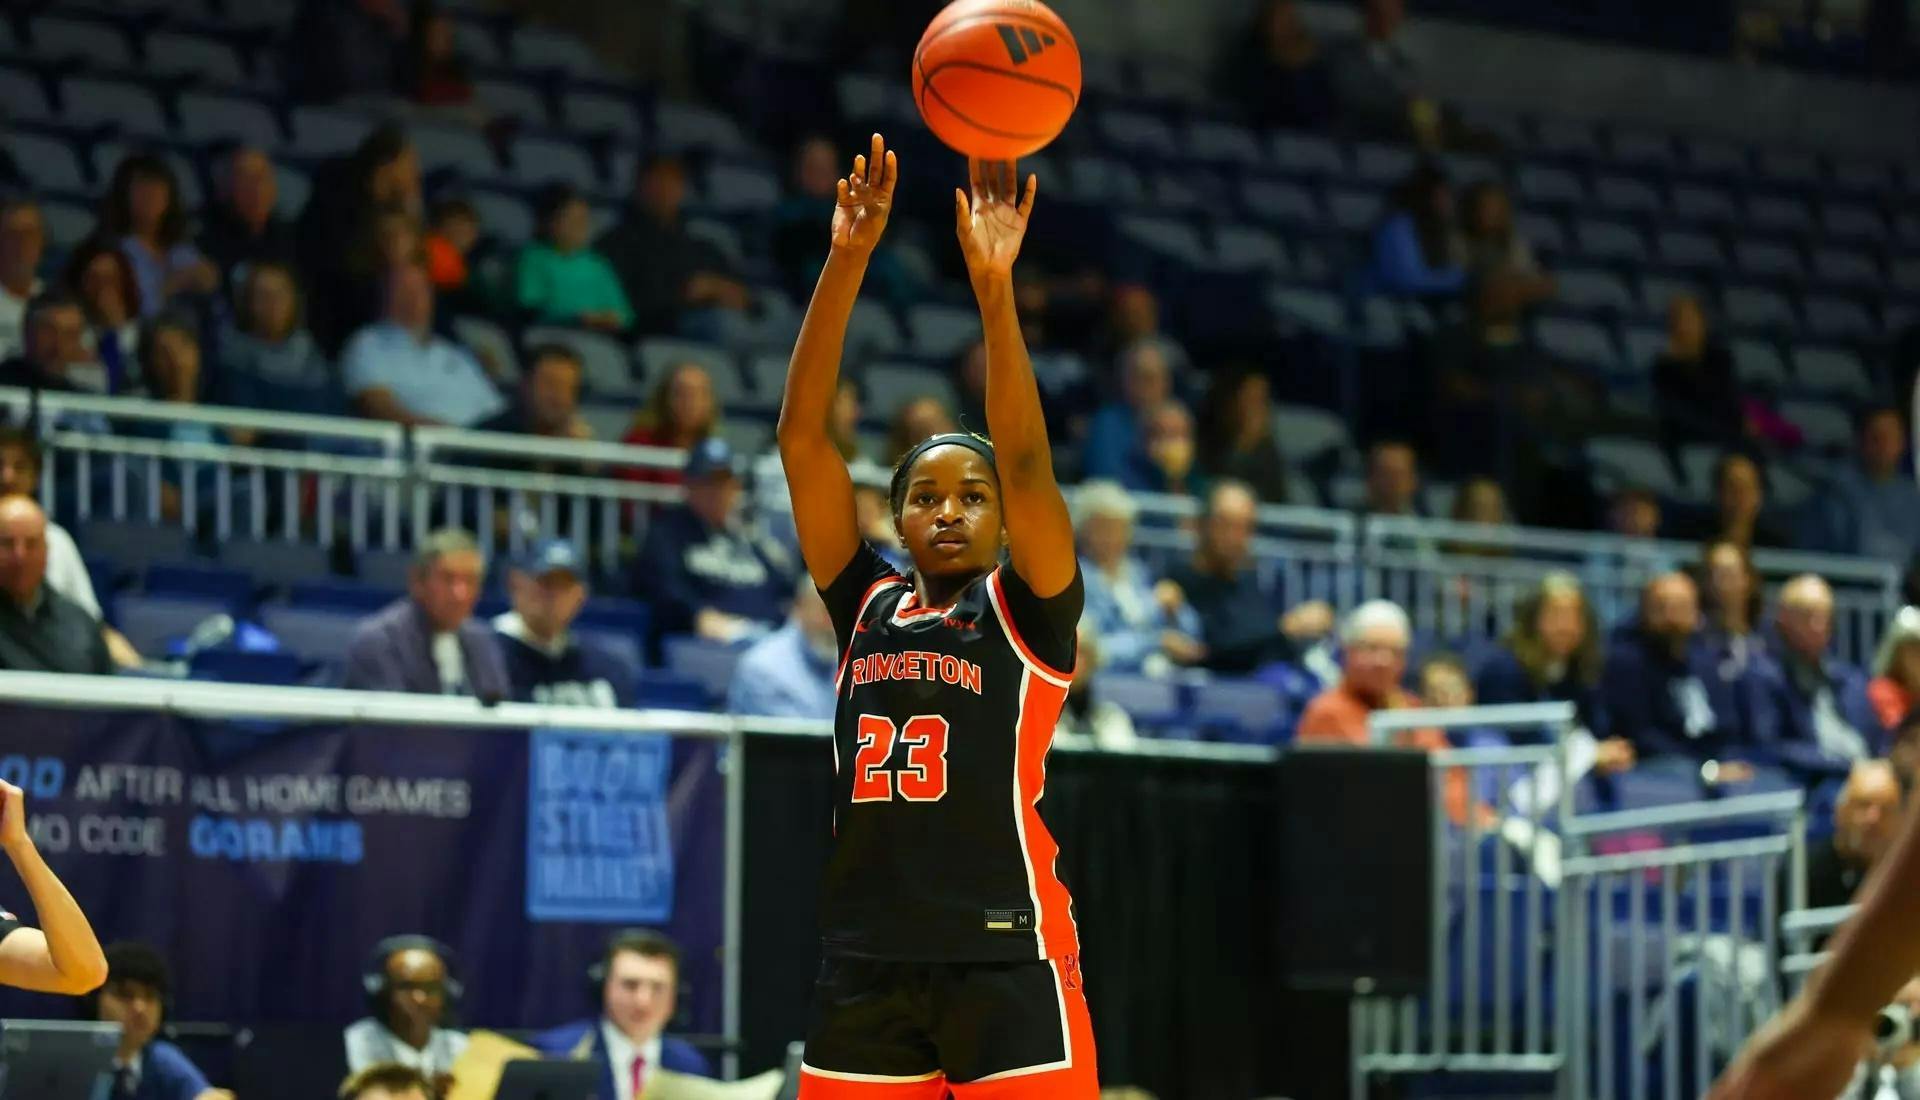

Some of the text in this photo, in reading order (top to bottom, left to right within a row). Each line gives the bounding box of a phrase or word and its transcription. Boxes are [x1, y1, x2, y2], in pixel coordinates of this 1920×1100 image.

[849, 651, 982, 699] RINCETON
[851, 713, 949, 803] 23
[75, 763, 184, 806] AFTER
[244, 774, 341, 814] HOME
[345, 774, 473, 819] GAMES
[77, 813, 166, 857] CODE
[1019, 915, 1028, 925] M
